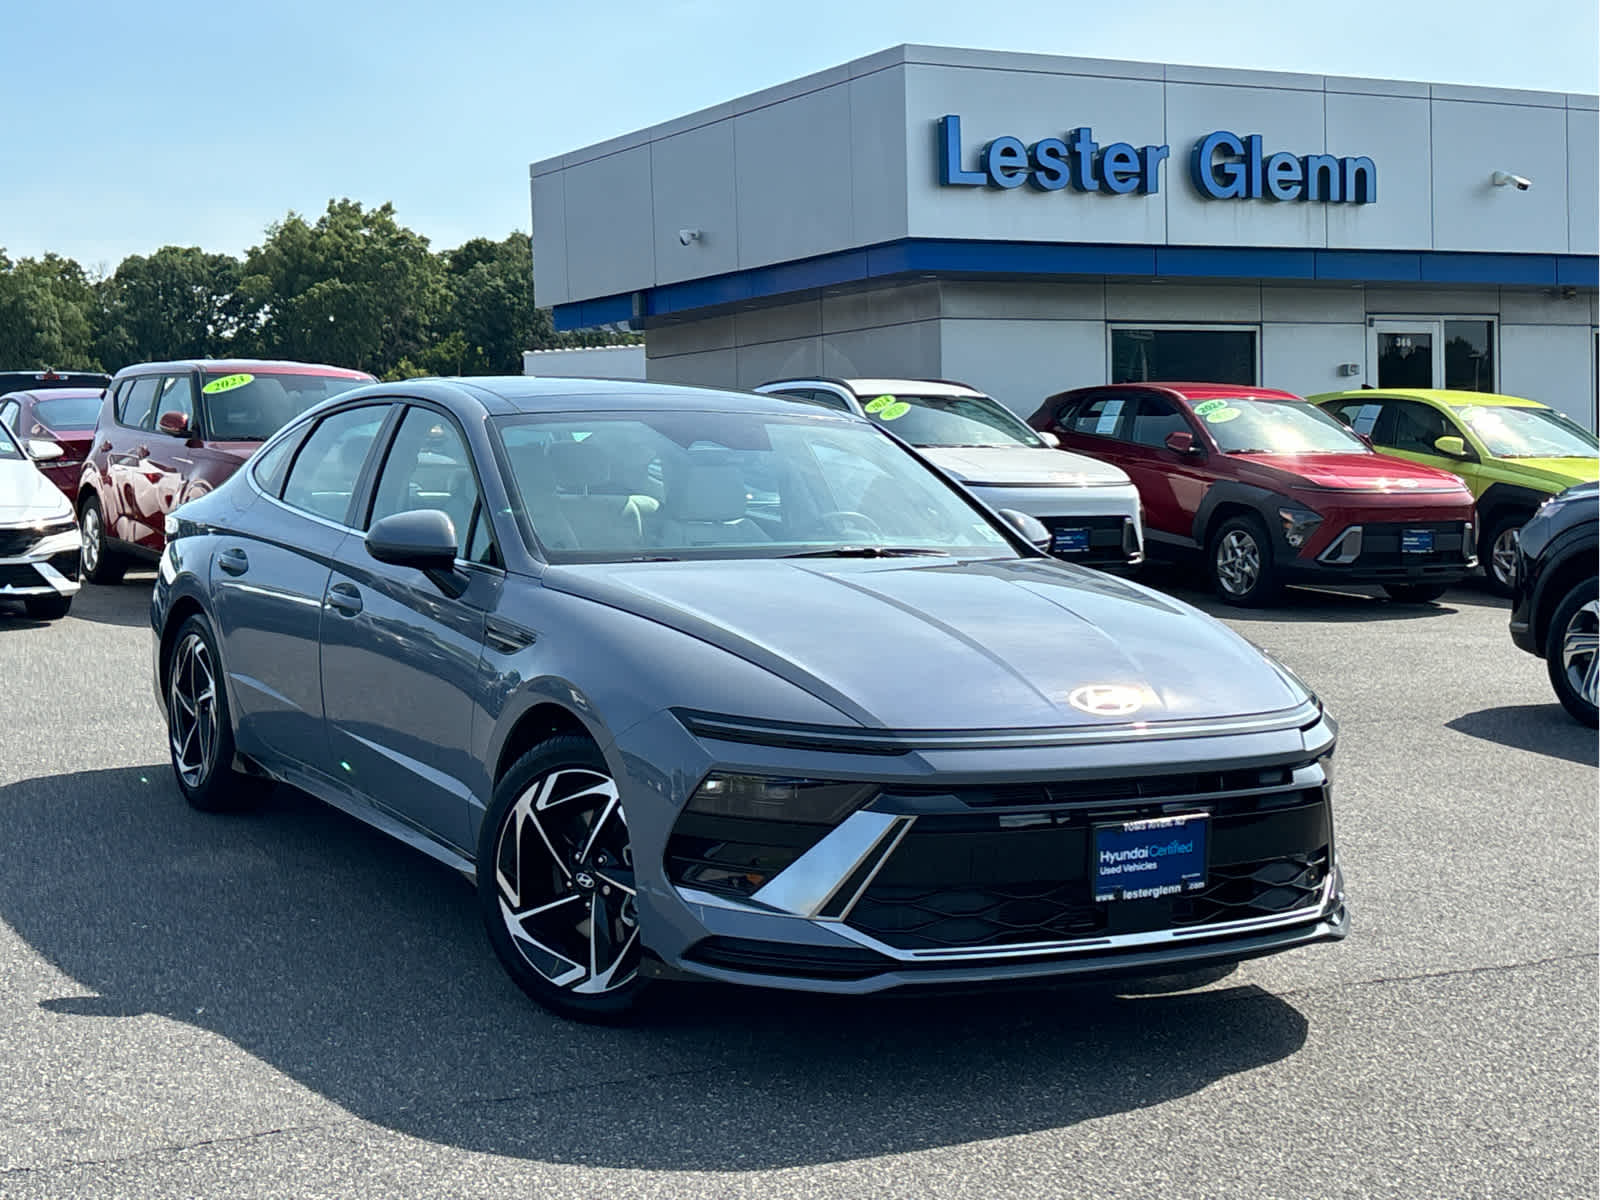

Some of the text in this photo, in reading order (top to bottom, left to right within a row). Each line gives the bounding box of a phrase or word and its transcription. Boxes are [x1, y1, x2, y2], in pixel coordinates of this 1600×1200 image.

[938, 115, 1377, 204] Lester Glenn
[1100, 840, 1193, 864] Hyundai Certified
[1100, 861, 1158, 876] Used Vehicles
[1123, 884, 1182, 900] lesterglenn
